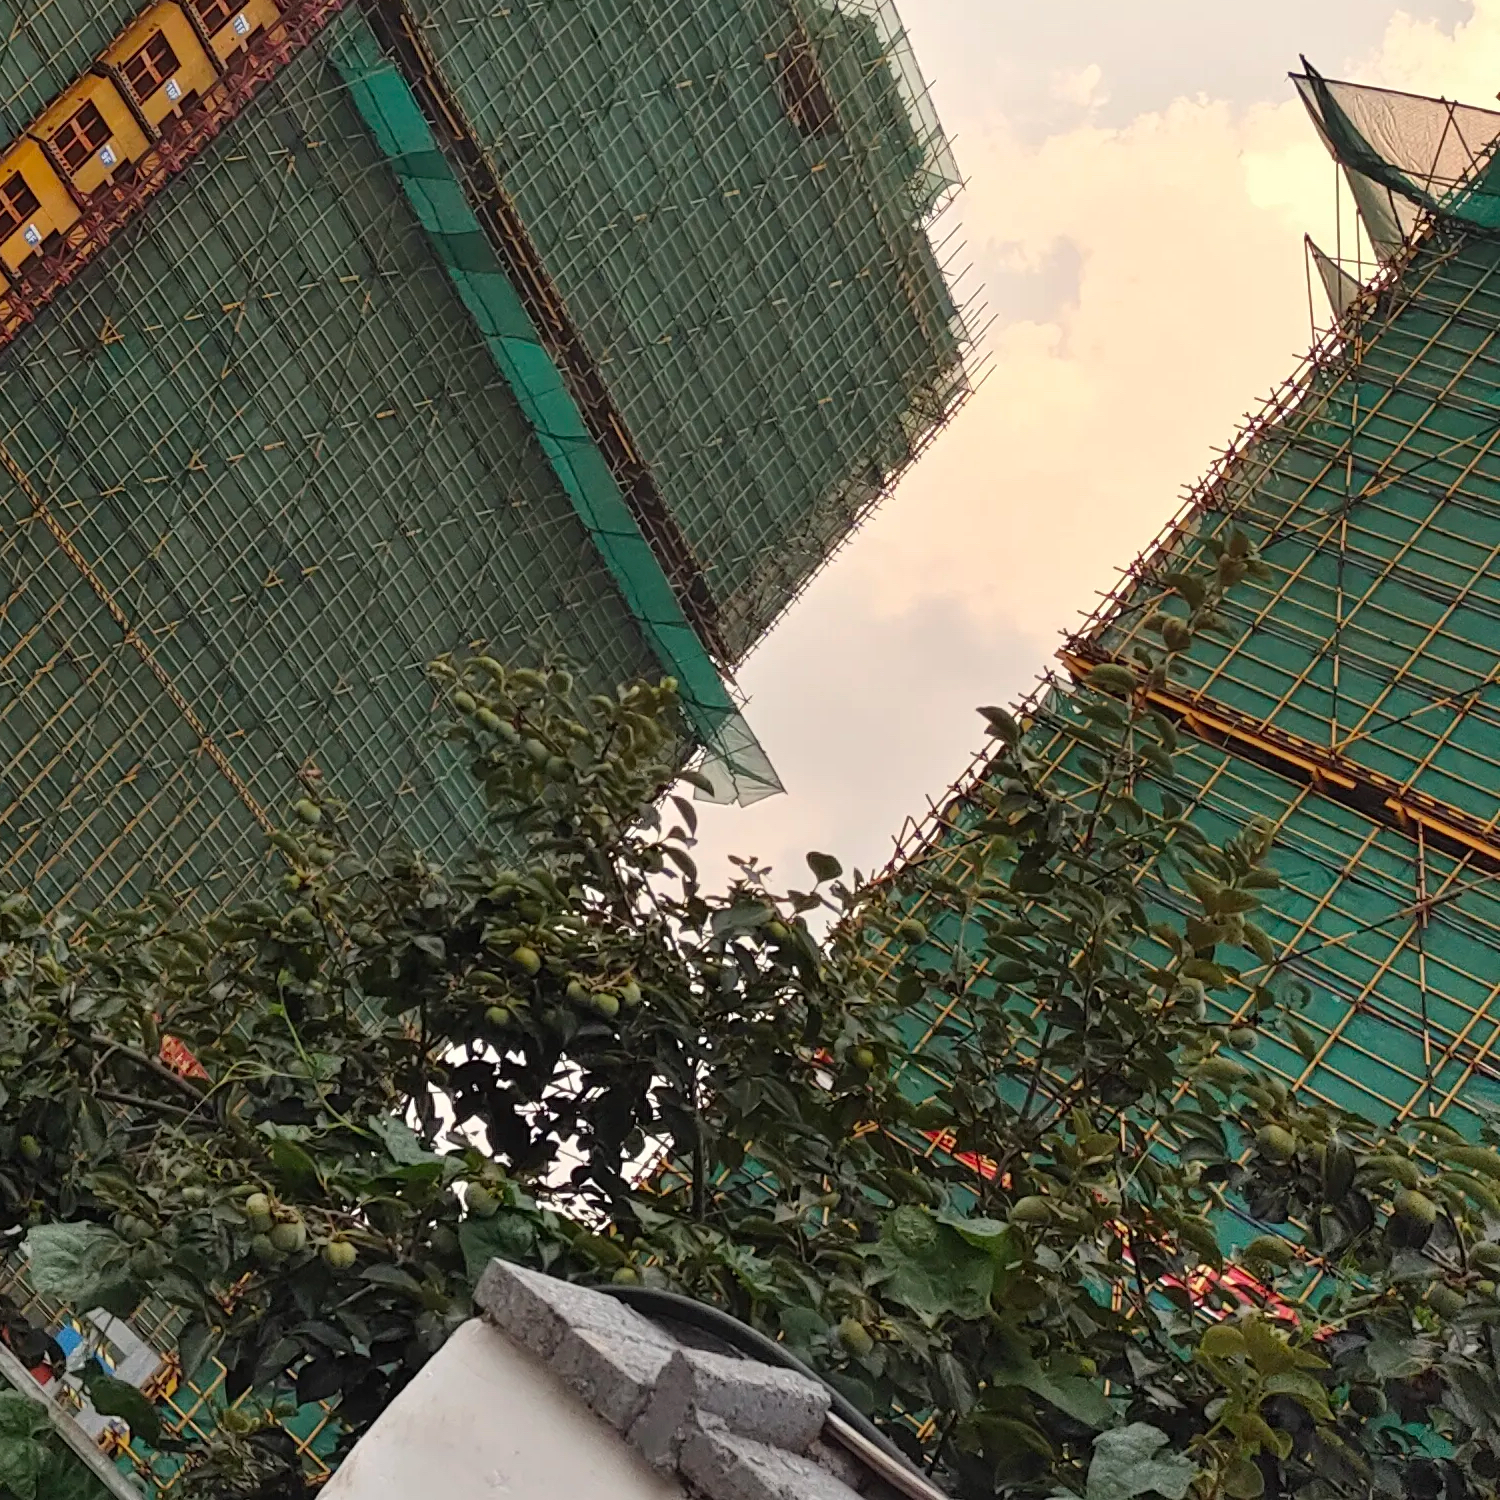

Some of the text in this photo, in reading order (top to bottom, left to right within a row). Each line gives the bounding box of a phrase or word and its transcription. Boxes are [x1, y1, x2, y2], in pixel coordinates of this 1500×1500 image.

[232, 18, 246, 36] 11F
[164, 83, 179, 101] 10F
[99, 150, 113, 166] 9F
[23, 229, 37, 245] 8F
